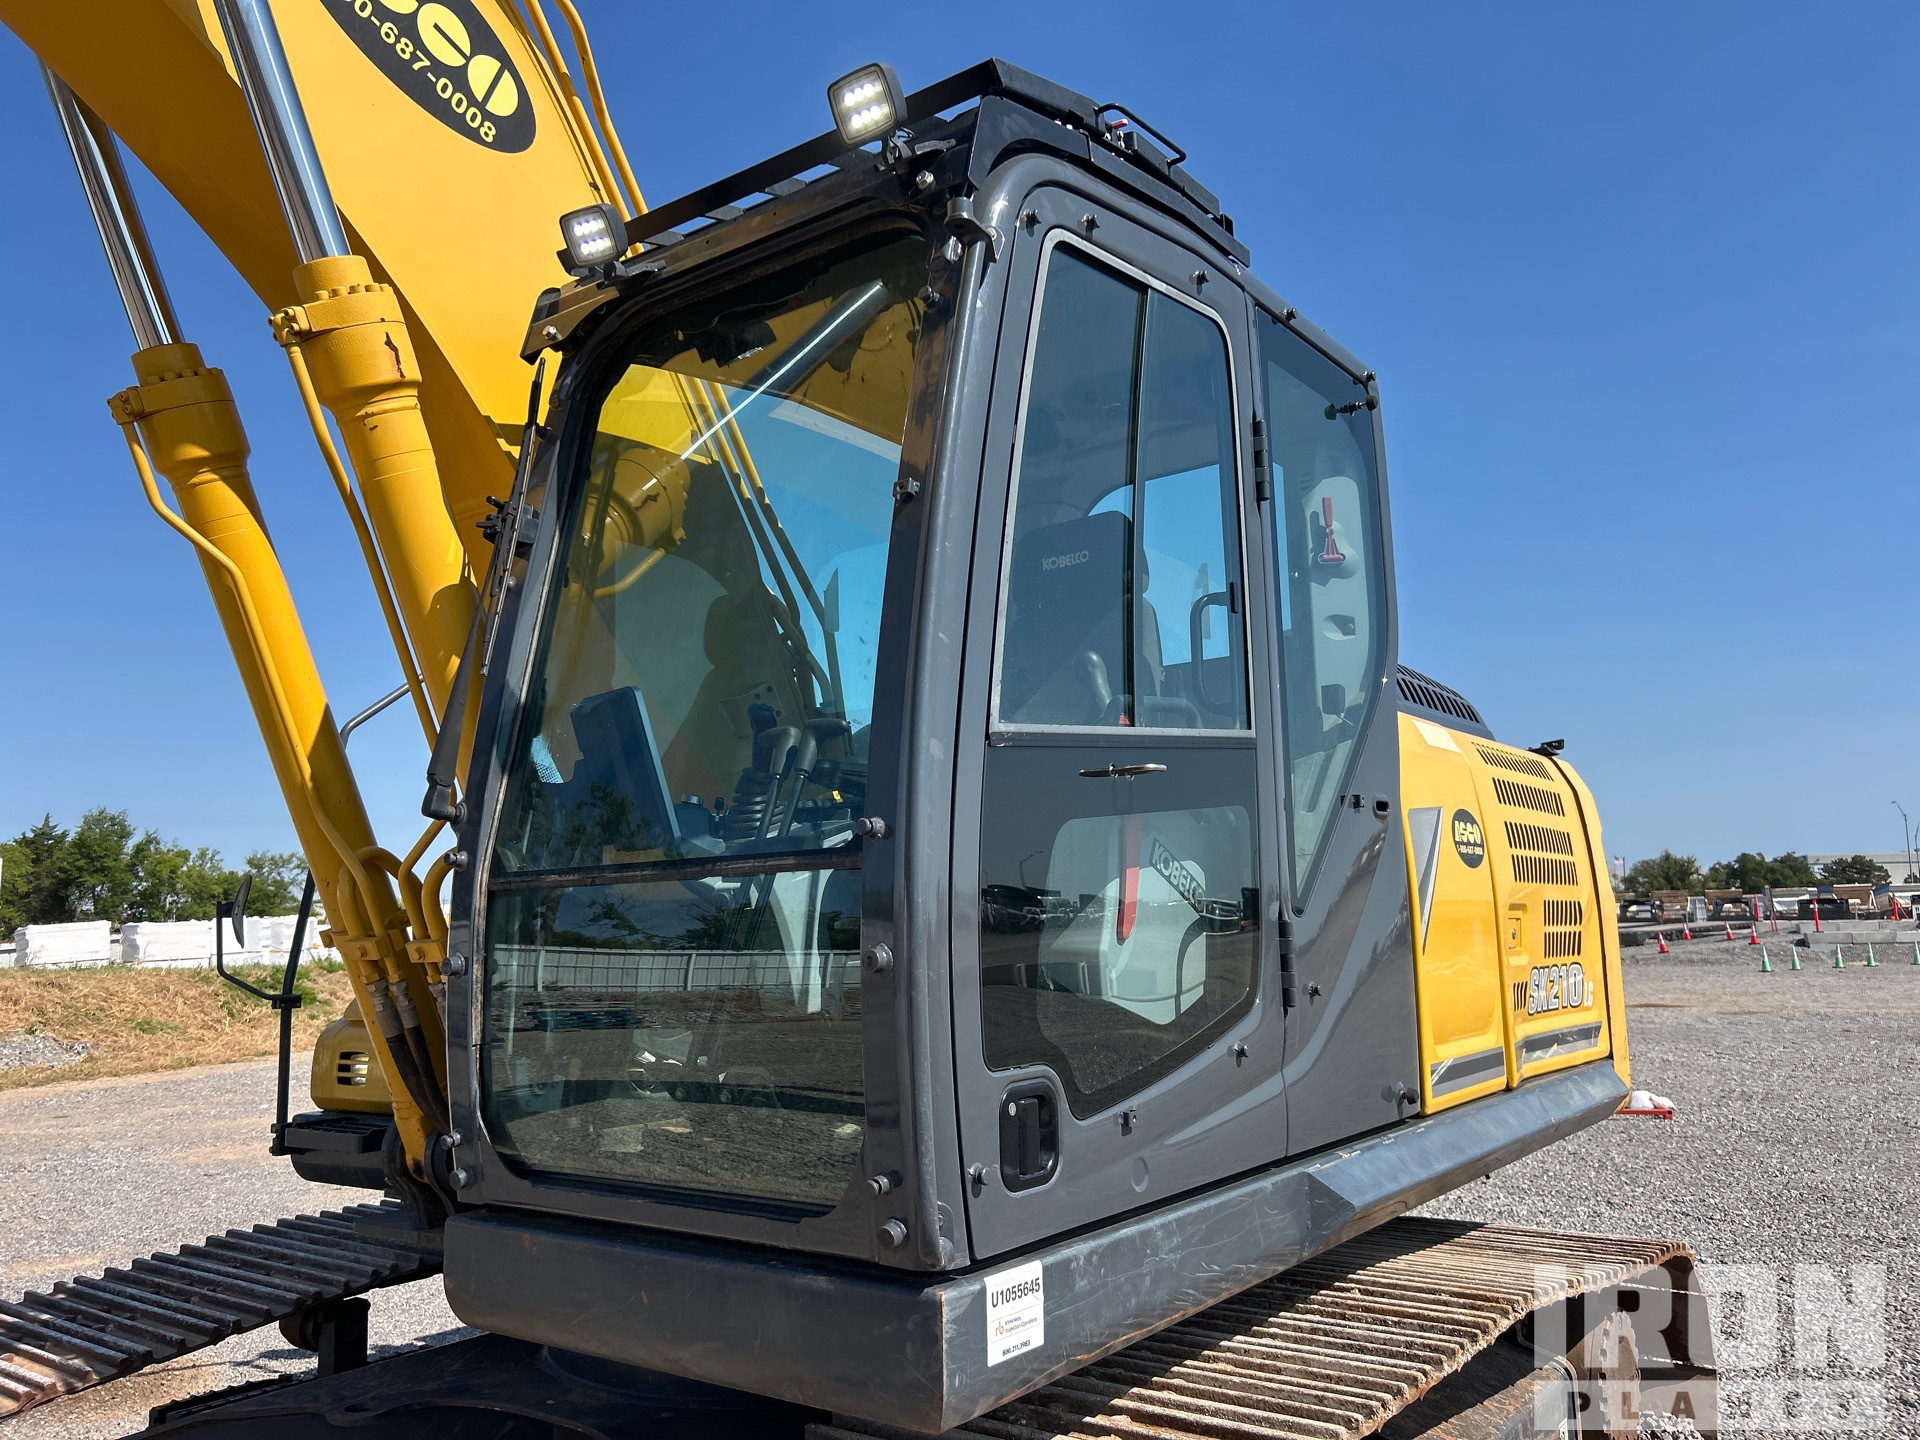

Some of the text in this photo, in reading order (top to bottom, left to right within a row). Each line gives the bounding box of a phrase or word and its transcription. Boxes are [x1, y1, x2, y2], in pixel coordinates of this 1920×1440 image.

[1042, 550, 1089, 571] KOBELCO
[1152, 841, 1205, 911] KOBELCO
[1528, 961, 1594, 1016] SK210 LC
[991, 1277, 1041, 1309] U1055645
